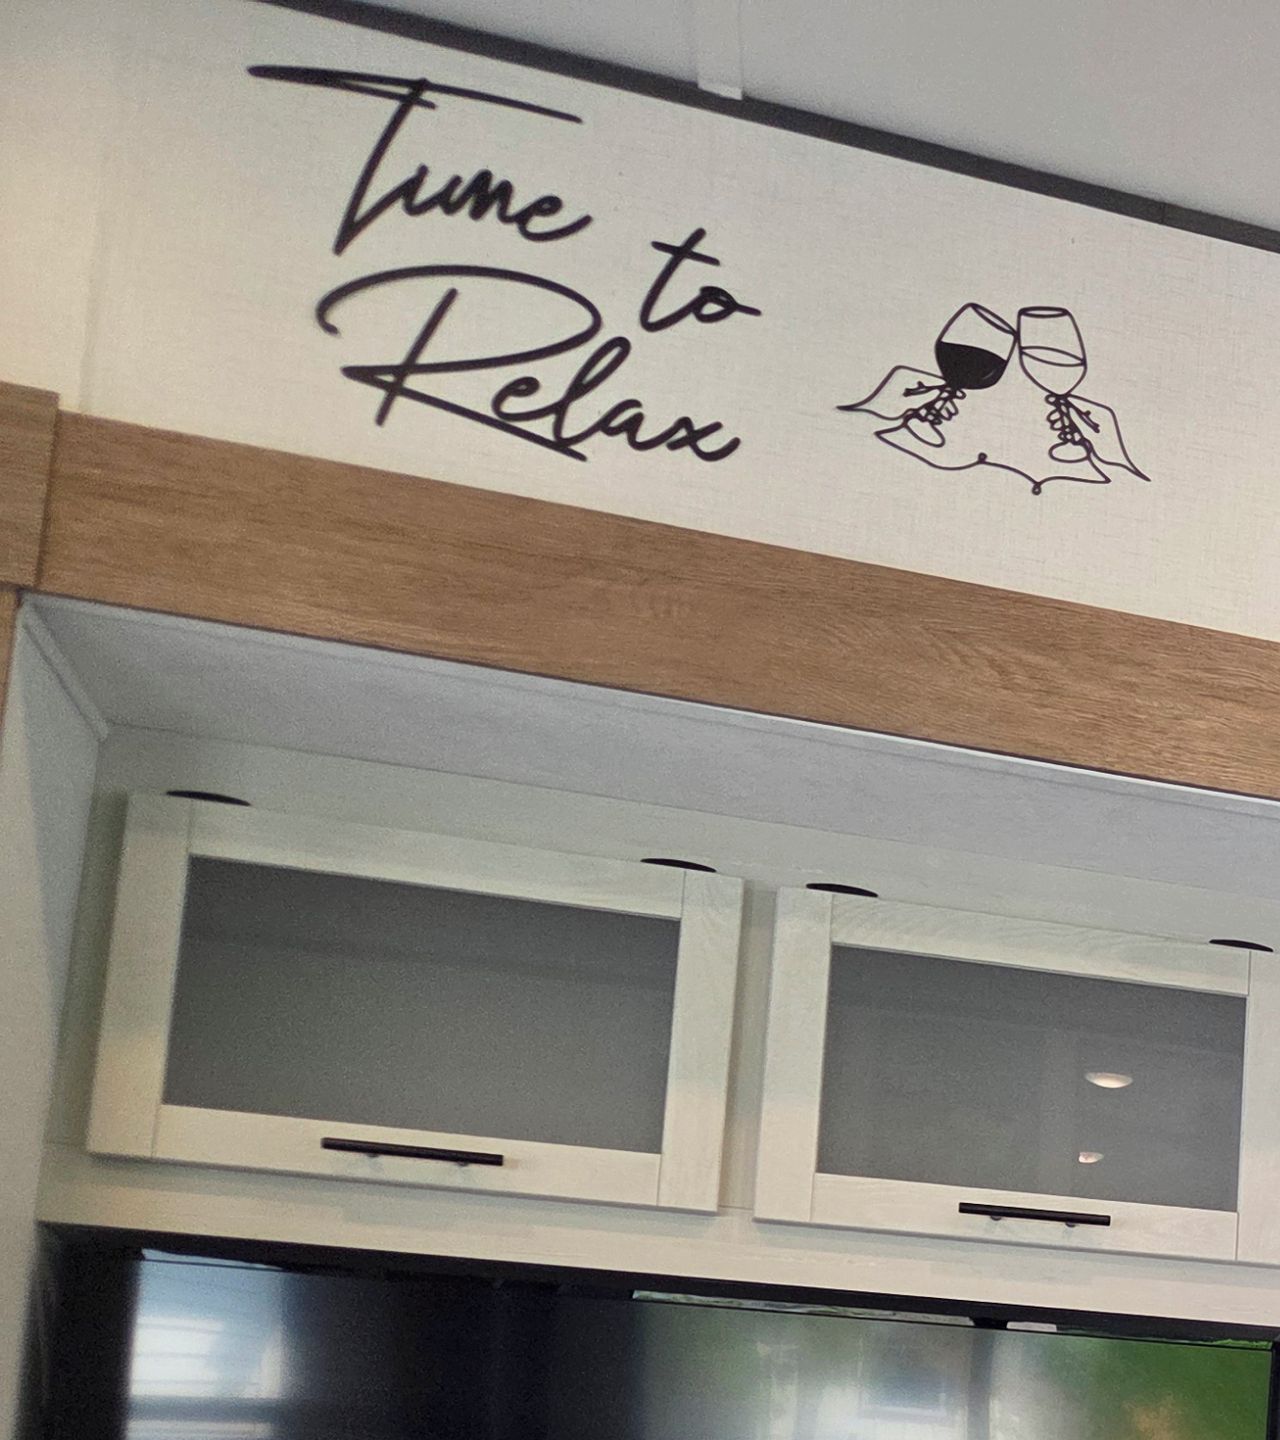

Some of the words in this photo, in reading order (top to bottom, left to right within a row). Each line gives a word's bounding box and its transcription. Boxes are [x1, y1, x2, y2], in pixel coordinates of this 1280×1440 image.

[247, 65, 592, 255] Time
[640, 228, 761, 332] to
[316, 265, 740, 461] Relax
